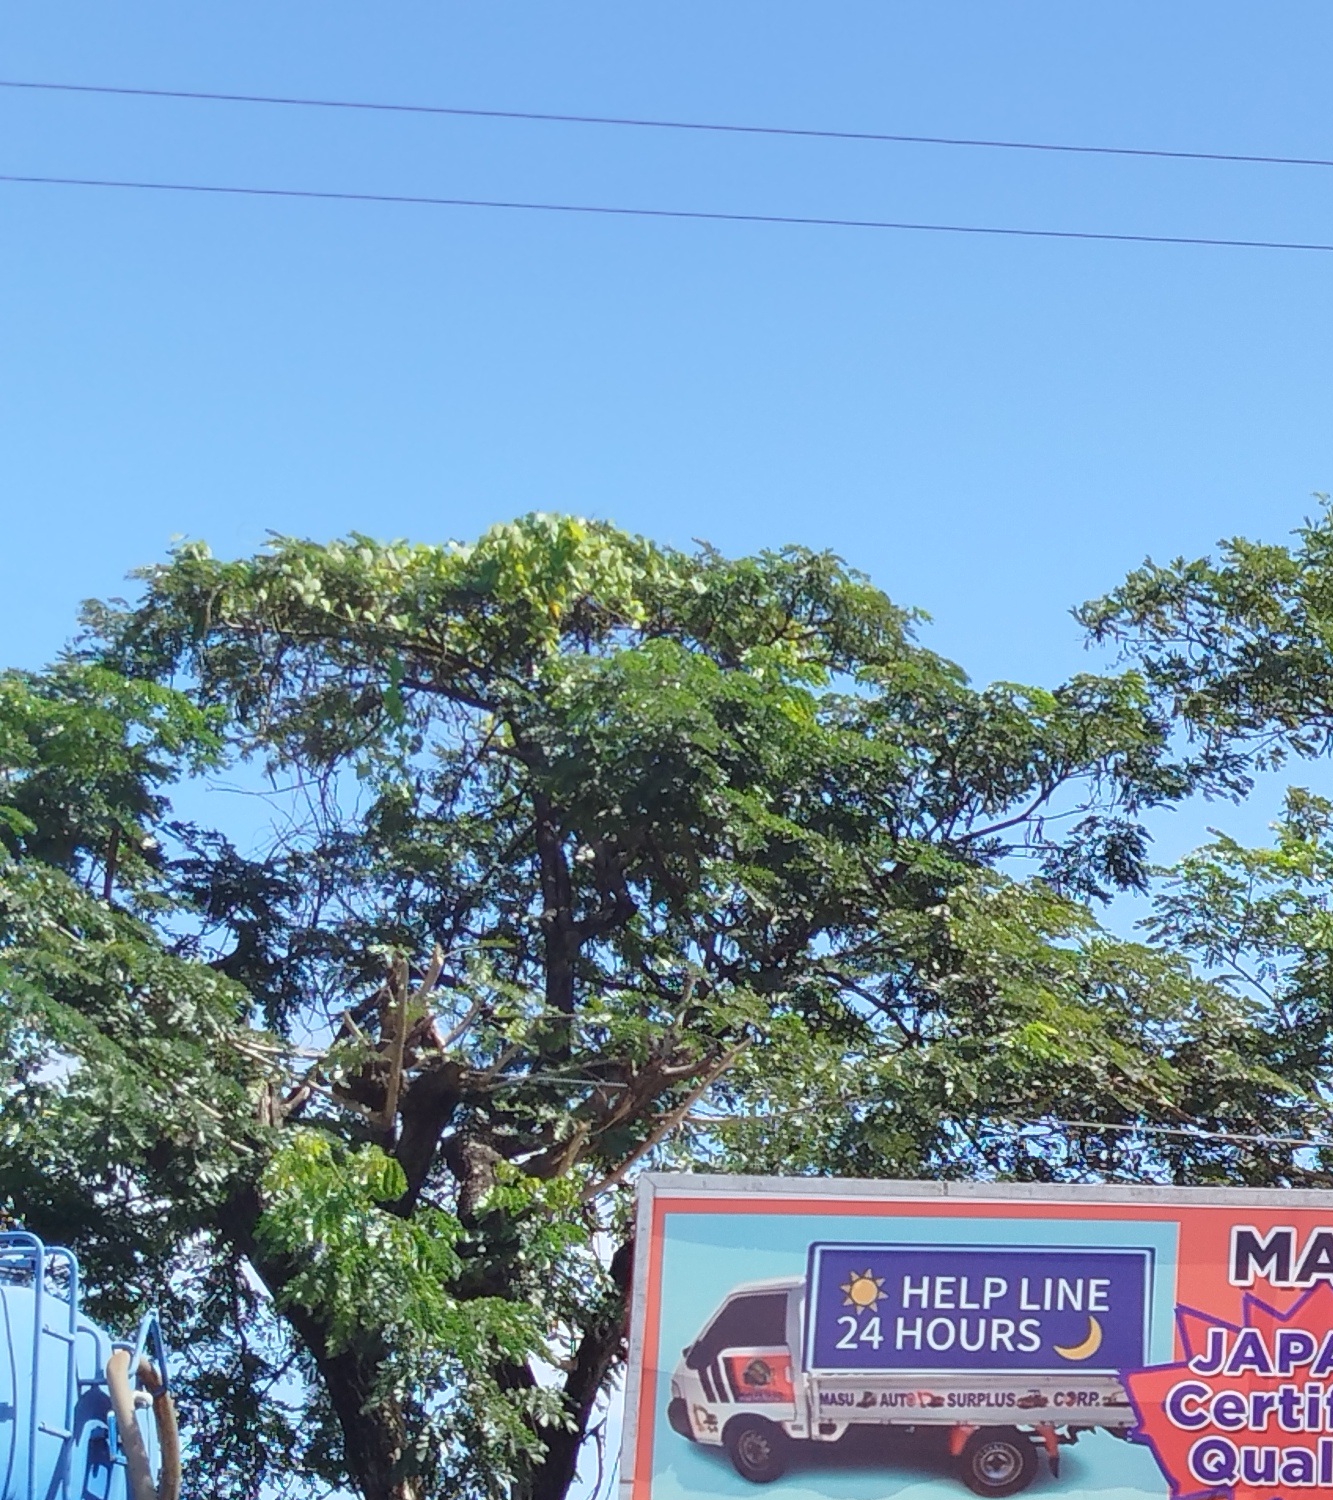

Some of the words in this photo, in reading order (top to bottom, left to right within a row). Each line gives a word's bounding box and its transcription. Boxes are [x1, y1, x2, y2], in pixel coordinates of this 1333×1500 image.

[902, 1275, 1009, 1310] HELP
[1019, 1278, 1112, 1312] LINE
[836, 1316, 885, 1350] 24
[895, 1316, 1042, 1352] HOURS
[818, 1391, 856, 1408] MASU
[946, 1392, 1017, 1408] SURPLUS
